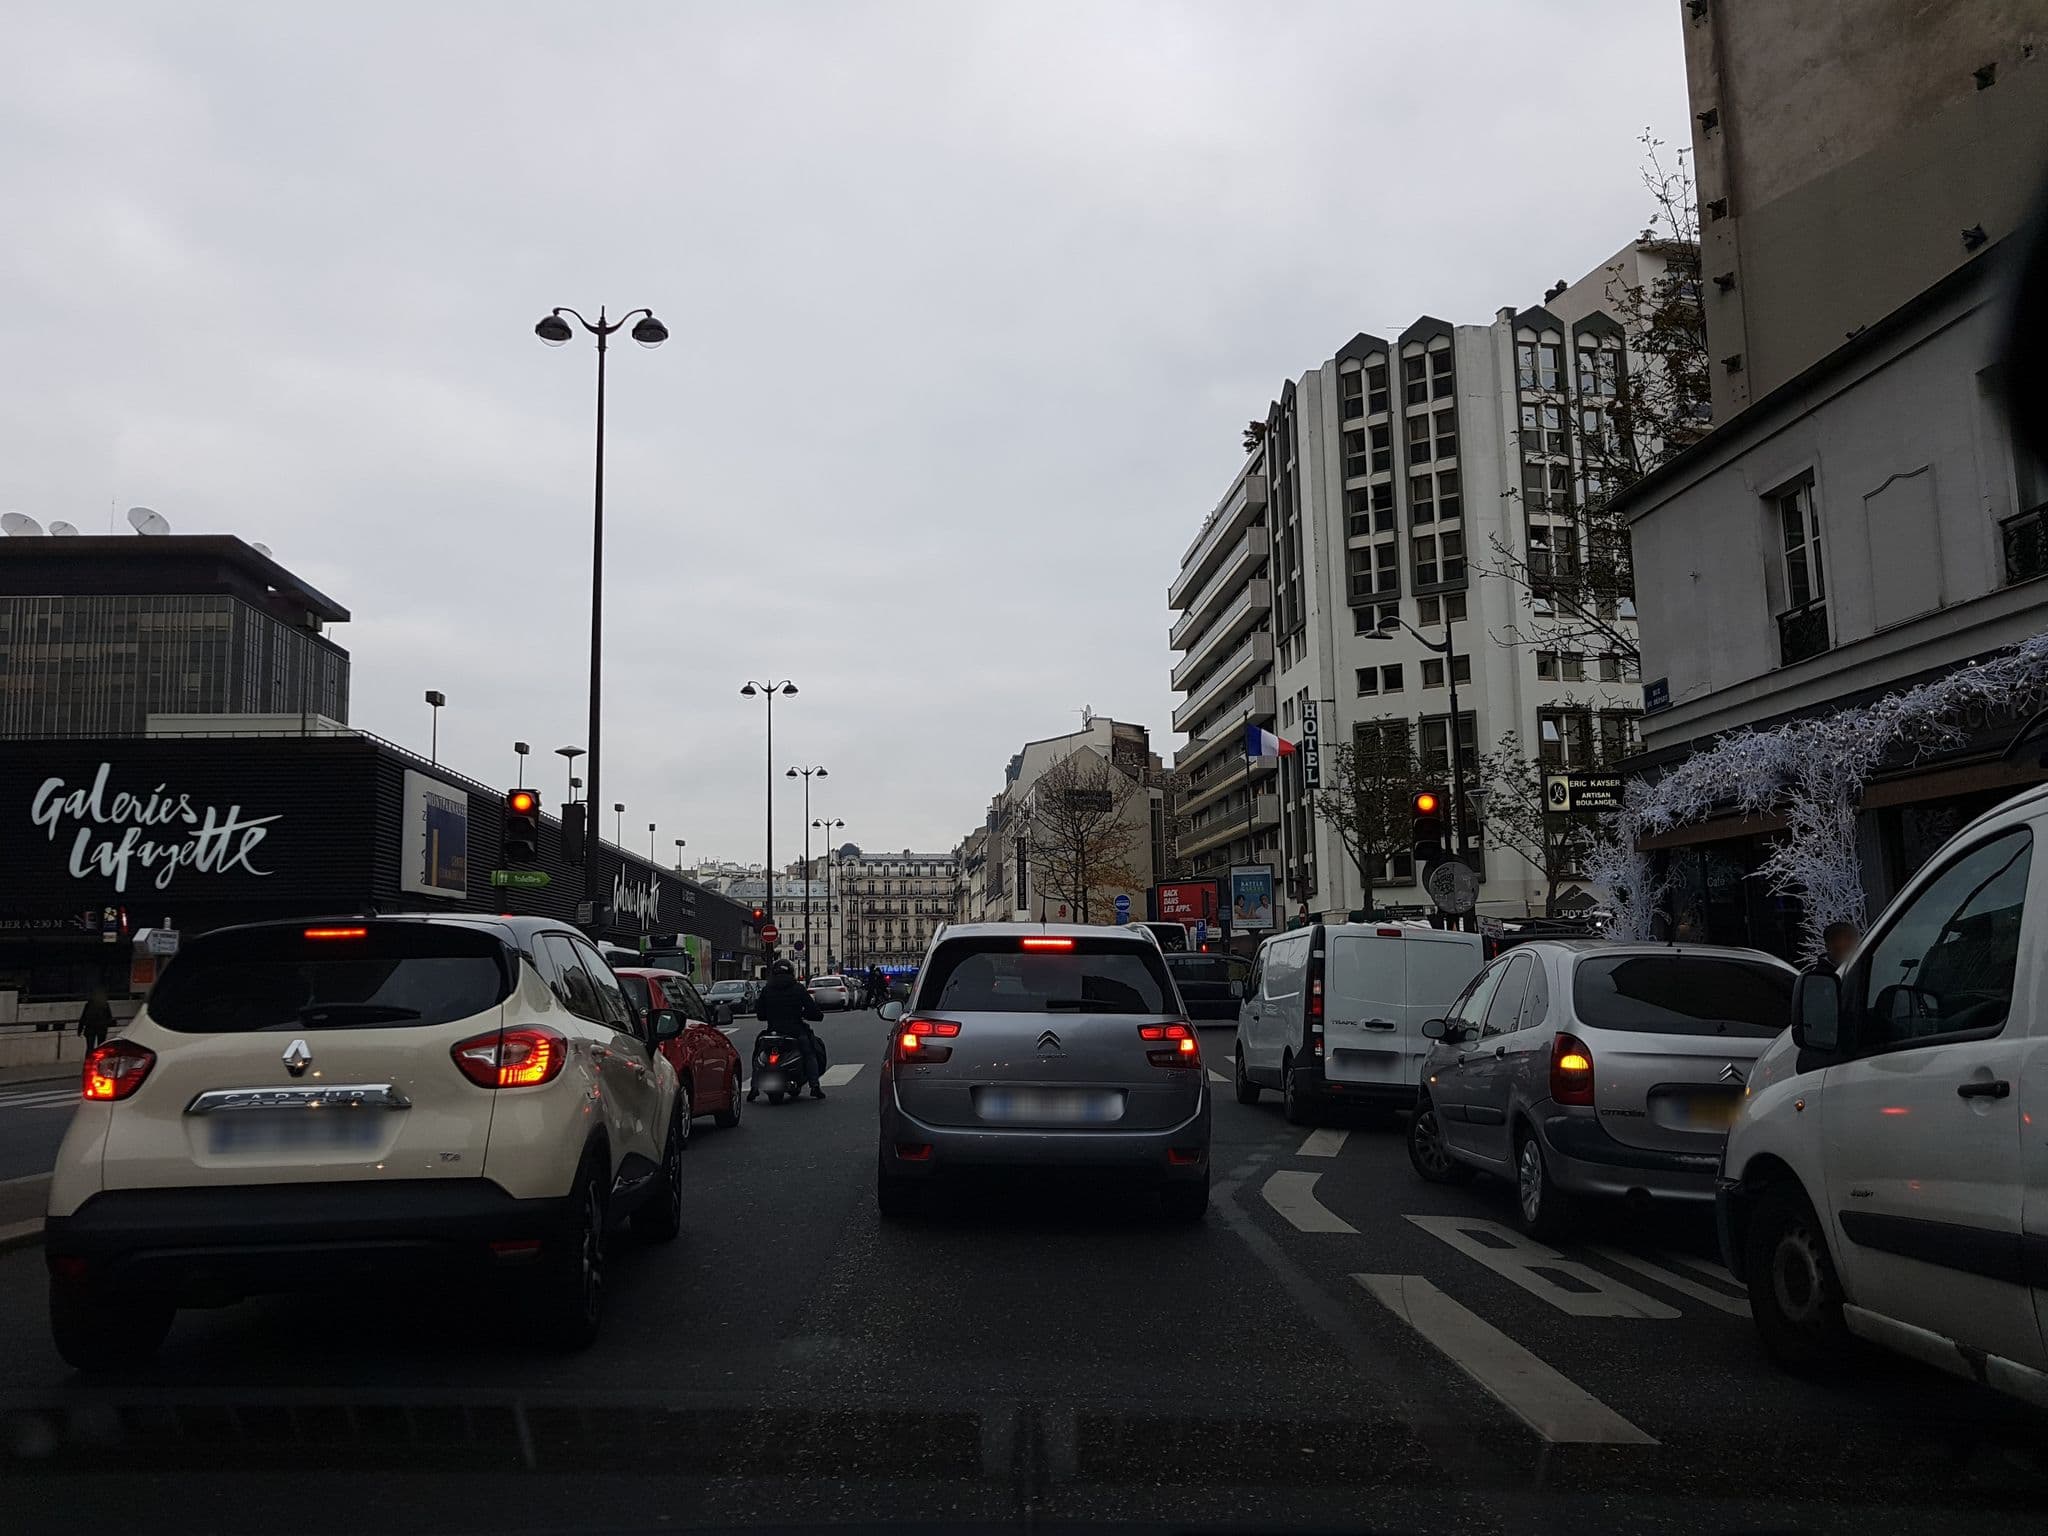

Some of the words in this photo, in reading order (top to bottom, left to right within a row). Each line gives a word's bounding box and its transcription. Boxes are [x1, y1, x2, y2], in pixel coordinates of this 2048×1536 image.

[1303, 703, 1319, 784] HOTEL
[31, 762, 198, 841] Galeries
[1569, 780, 1587, 788] ERIC
[1590, 779, 1621, 787] KAYSER
[1575, 799, 1617, 807] BOULANGER
[69, 805, 284, 892] Lafayette
